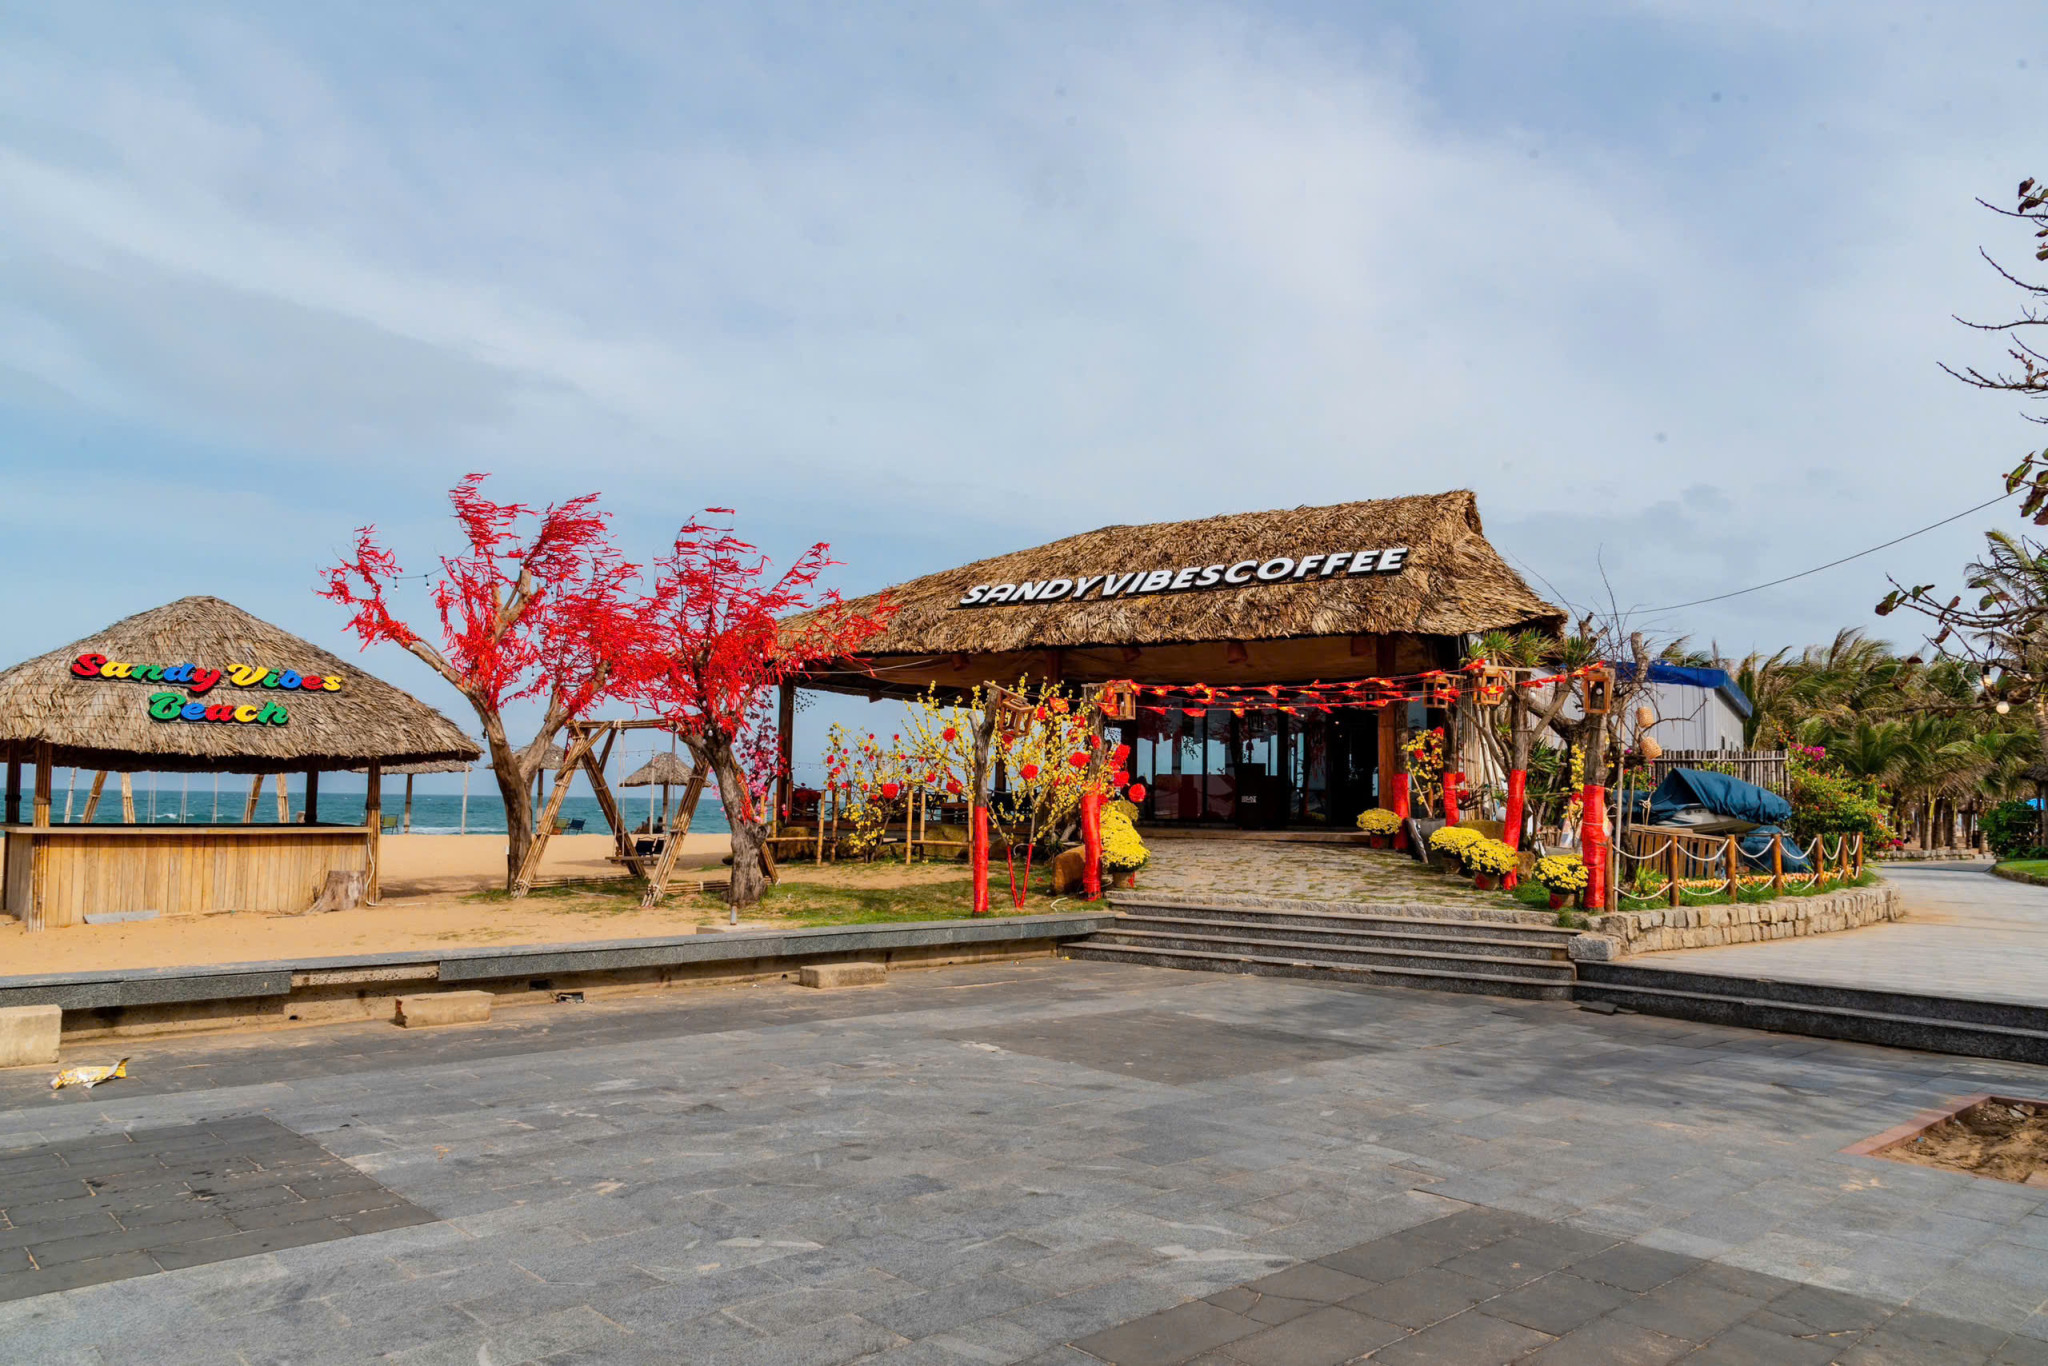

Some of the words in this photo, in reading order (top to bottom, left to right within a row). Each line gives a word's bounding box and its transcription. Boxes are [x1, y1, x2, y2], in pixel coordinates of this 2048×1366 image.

[71, 653, 221, 692] Sandy
[227, 663, 342, 692] Vibes
[149, 692, 289, 724] Beach
